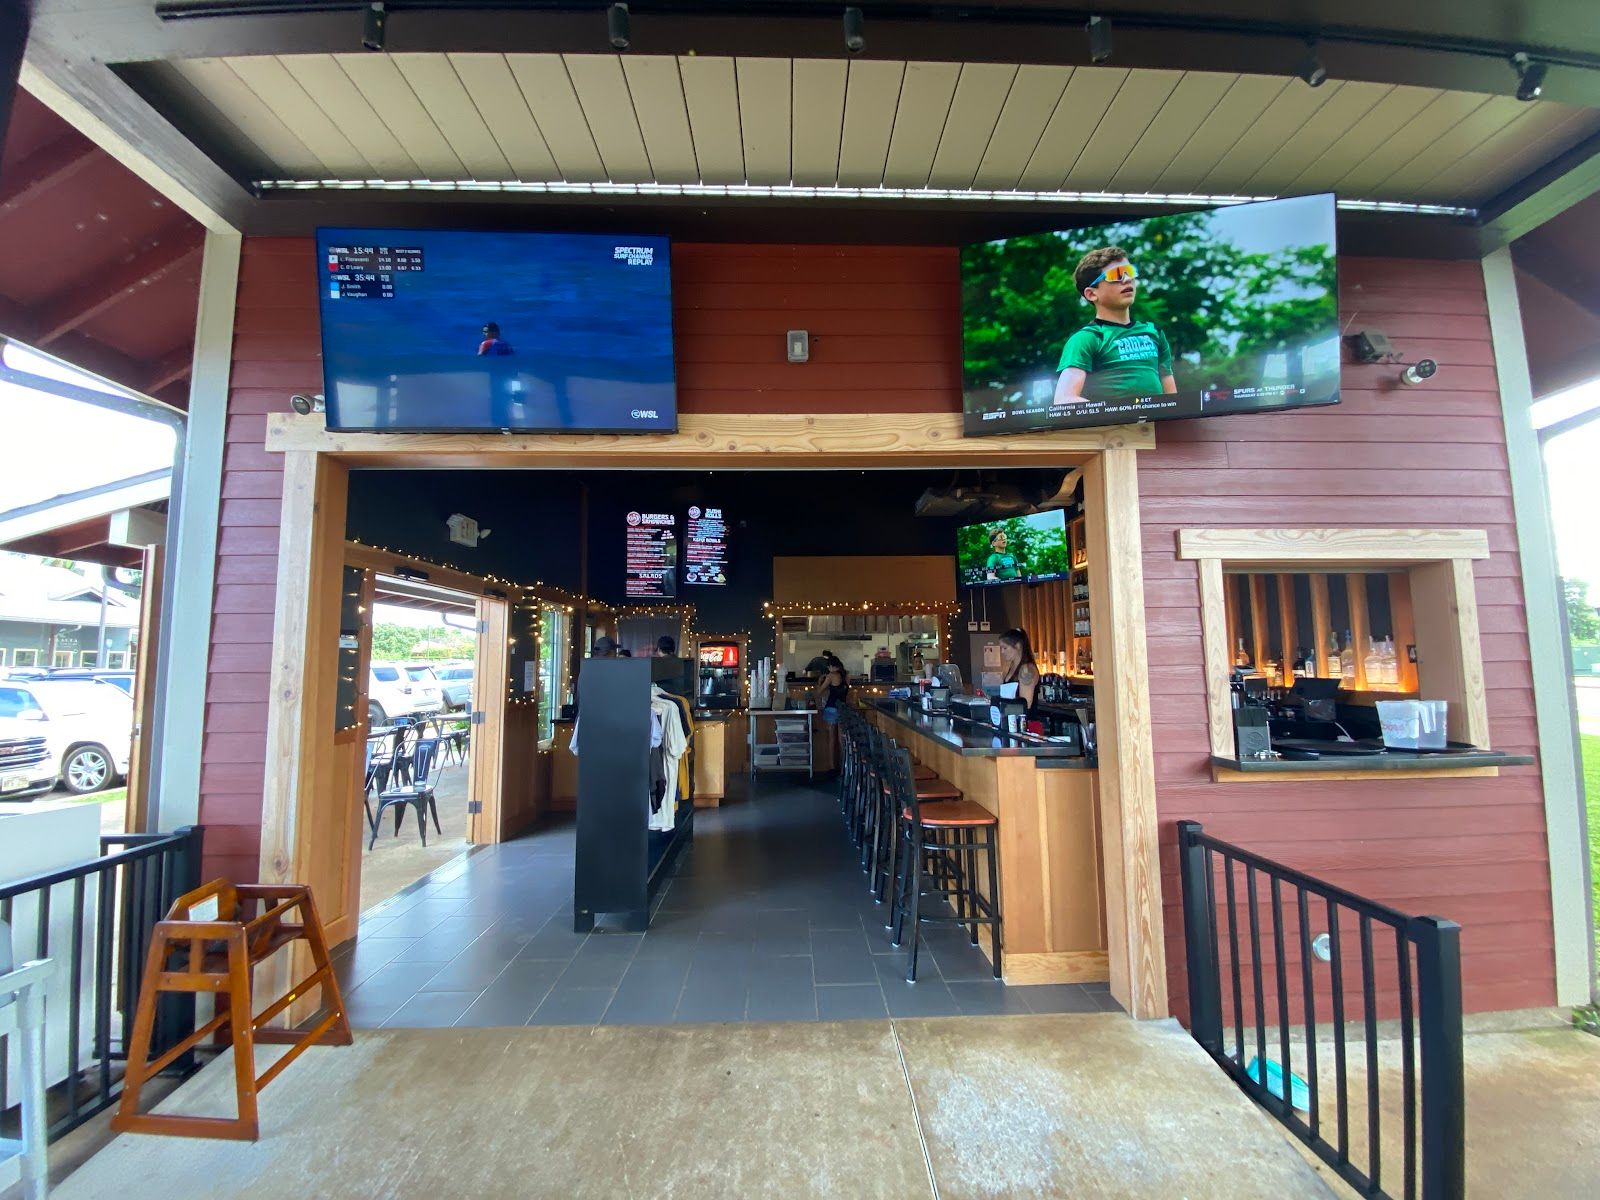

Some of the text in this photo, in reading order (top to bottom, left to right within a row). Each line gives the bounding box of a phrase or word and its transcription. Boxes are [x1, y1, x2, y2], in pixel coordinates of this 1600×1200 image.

[353, 246, 374, 255] 15:44
[615, 246, 653, 254] SPECTRUM
[627, 258, 653, 266] REPLAY
[354, 273, 376, 282] 35:44
[1233, 387, 1256, 395] SPURS
[1264, 383, 1295, 392] THUNDER
[1141, 401, 1161, 409] chance
[639, 410, 659, 419] WSL
[982, 411, 1006, 421] ESPN
